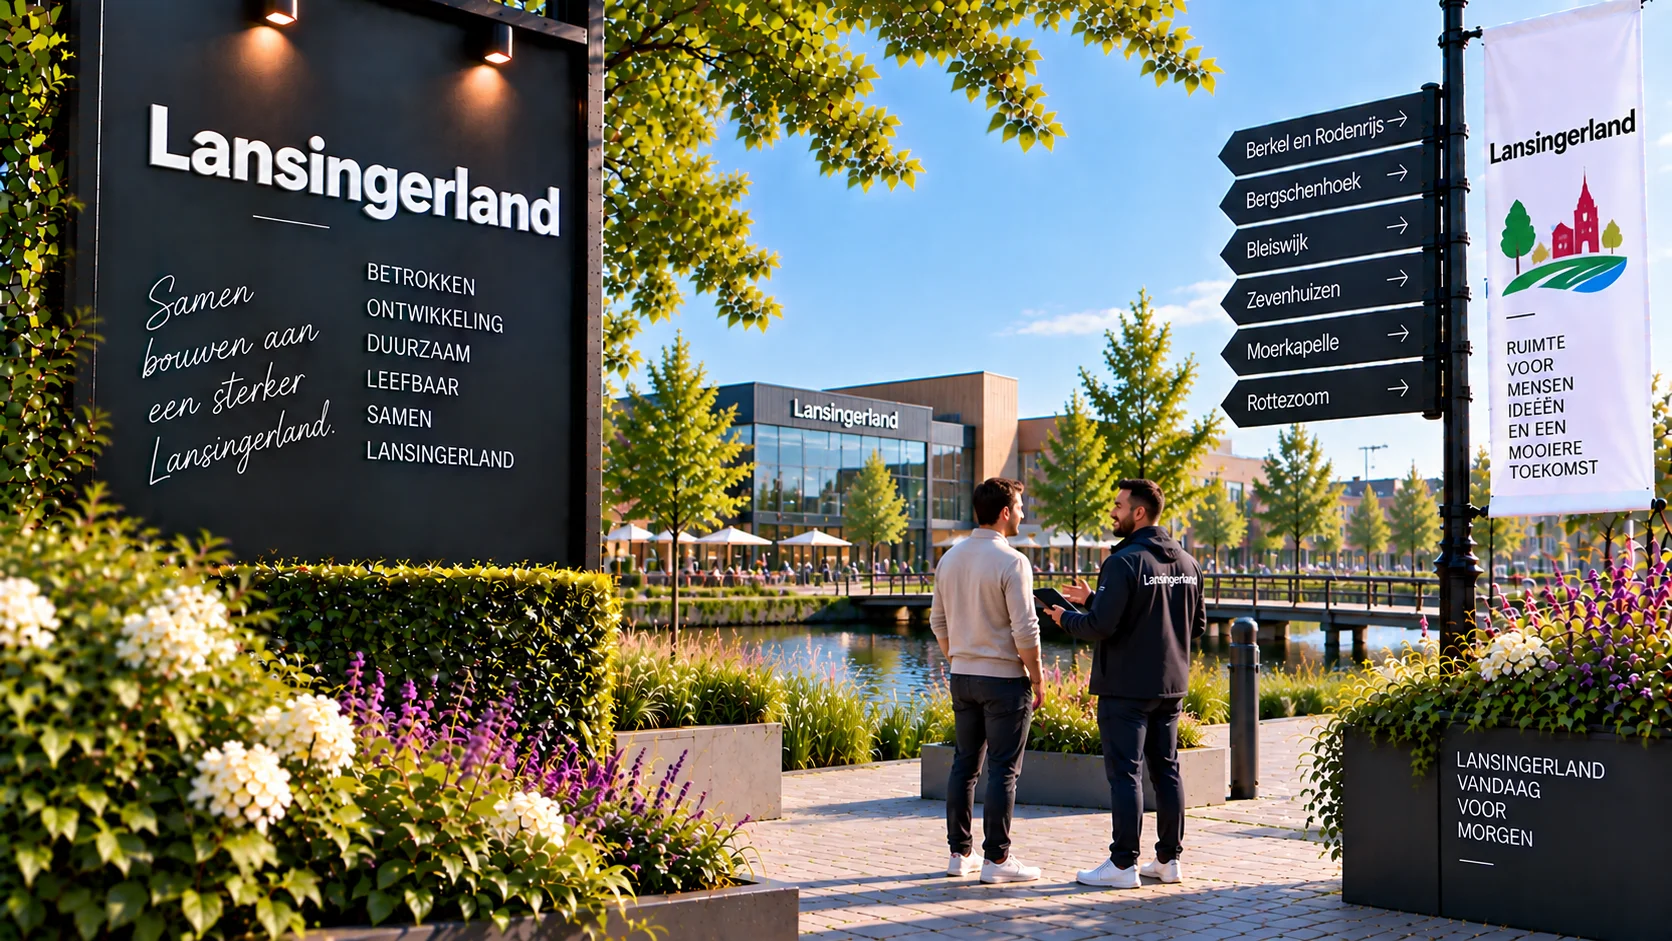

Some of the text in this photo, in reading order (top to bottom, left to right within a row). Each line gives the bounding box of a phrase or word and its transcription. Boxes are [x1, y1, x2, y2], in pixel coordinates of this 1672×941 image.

[1247, 116, 1384, 158] Berkel en Rodenrijs
[1490, 109, 1635, 164] Lansingerland
[149, 103, 560, 236] Lansingerland
[1247, 172, 1361, 208] Bergschenhoek
[1248, 233, 1308, 258] Bleiswijk
[368, 263, 474, 295] BETROKKEN
[146, 275, 254, 330] Samen
[1247, 283, 1340, 308] Zevenhuizen
[367, 299, 503, 333] ONTWIKKELING
[142, 324, 319, 379] bouwen aan
[368, 334, 469, 362] DUURZAAM
[1248, 333, 1339, 360] Moerkapelle
[1507, 335, 1565, 355] RUIMTE
[1507, 358, 1553, 376] VOOR
[149, 362, 305, 423] een sterker
[368, 370, 458, 396] LEEFBAAR
[1508, 377, 1574, 397] MENSEN
[794, 398, 899, 428] Lansingerland
[1248, 391, 1329, 411] Rottezoom
[368, 405, 431, 428] SAMEN
[1509, 420, 1565, 438] EN EEN
[149, 400, 335, 485] Lansingerland.
[368, 441, 514, 468] LANSINGERLAND
[1510, 441, 1582, 459] MOOIERE
[1509, 460, 1598, 479] TOEKOMST
[1143, 573, 1198, 587] Lansingerland
[1457, 751, 1605, 779] LANSINGERLAND
[1457, 774, 1540, 798] VANDAAG
[1458, 798, 1506, 819] VOOR
[1459, 822, 1532, 847] MORGEN
